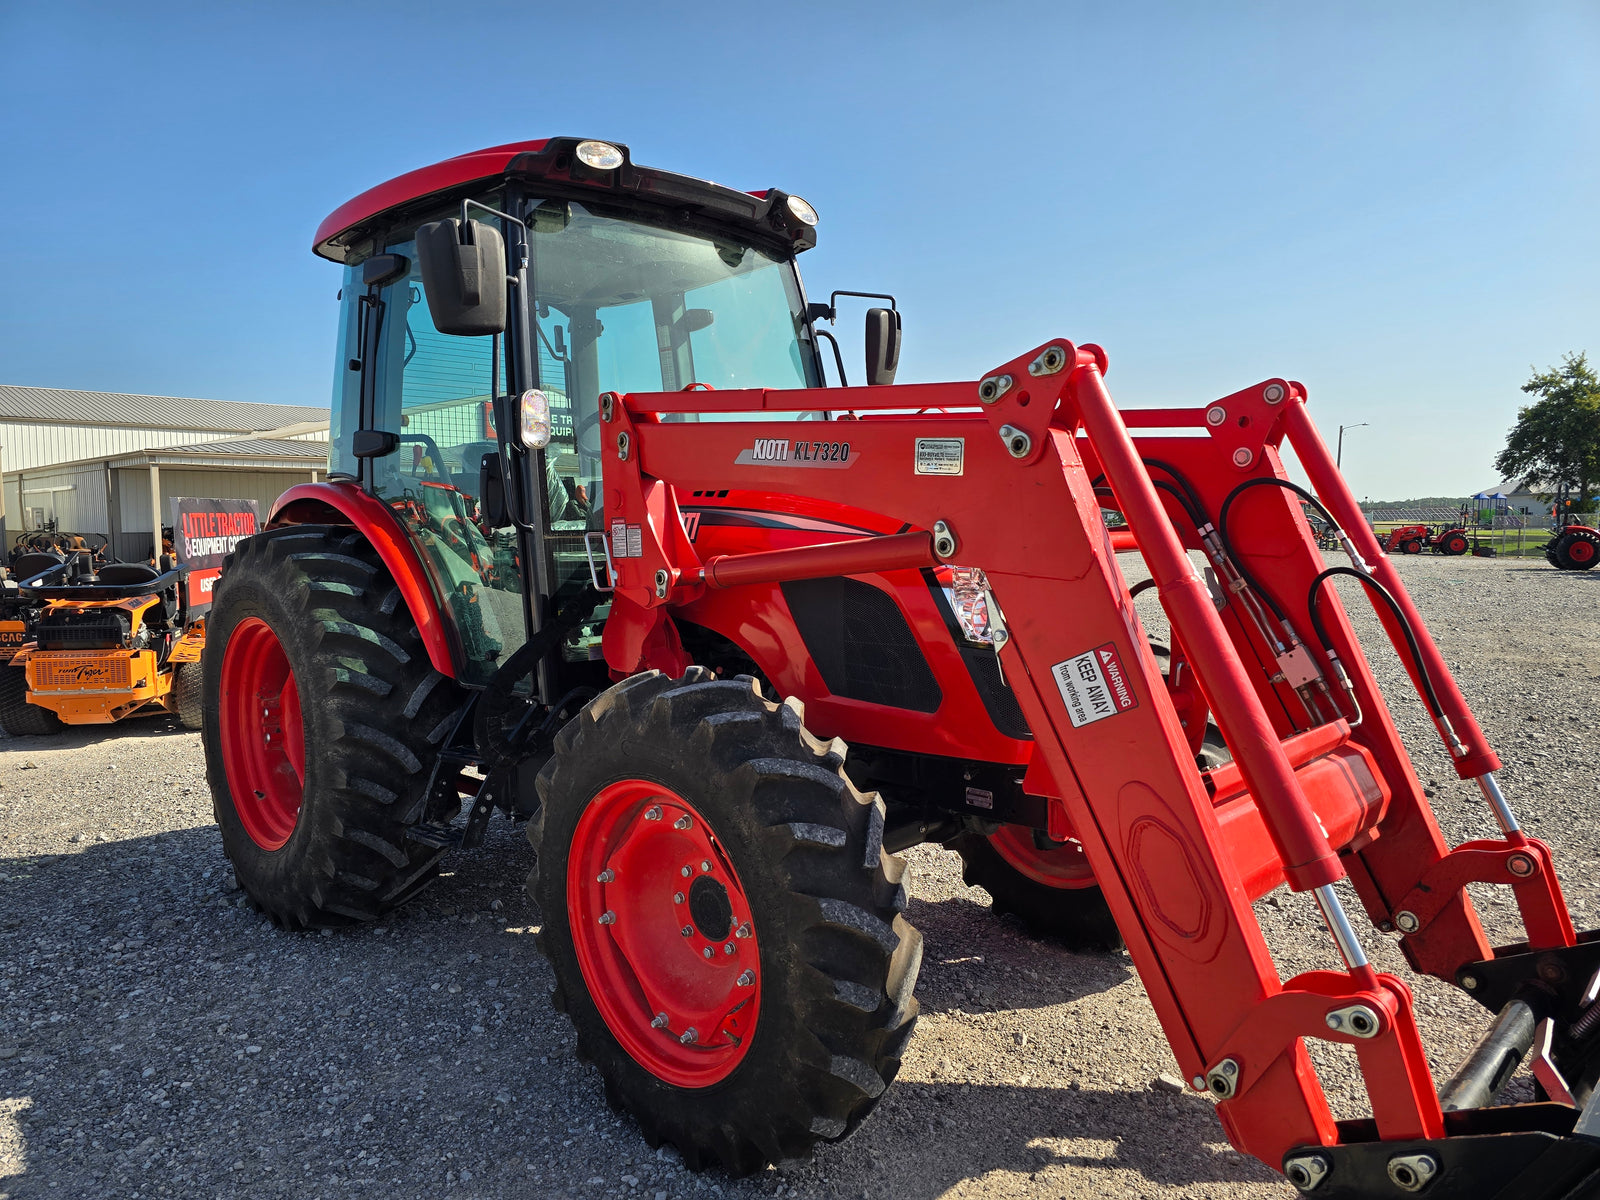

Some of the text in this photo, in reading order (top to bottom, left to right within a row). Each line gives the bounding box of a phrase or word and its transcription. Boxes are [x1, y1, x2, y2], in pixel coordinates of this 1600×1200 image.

[752, 438, 851, 462] KIOTI KL7320
[182, 512, 256, 539] LITTLE TRACTOR
[191, 536, 228, 557] EQUIPMENT
[200, 576, 217, 593] USE
[1059, 664, 1088, 723] from working area
[1075, 655, 1111, 714] KEEP AWAY
[1106, 661, 1132, 708] WARNING
